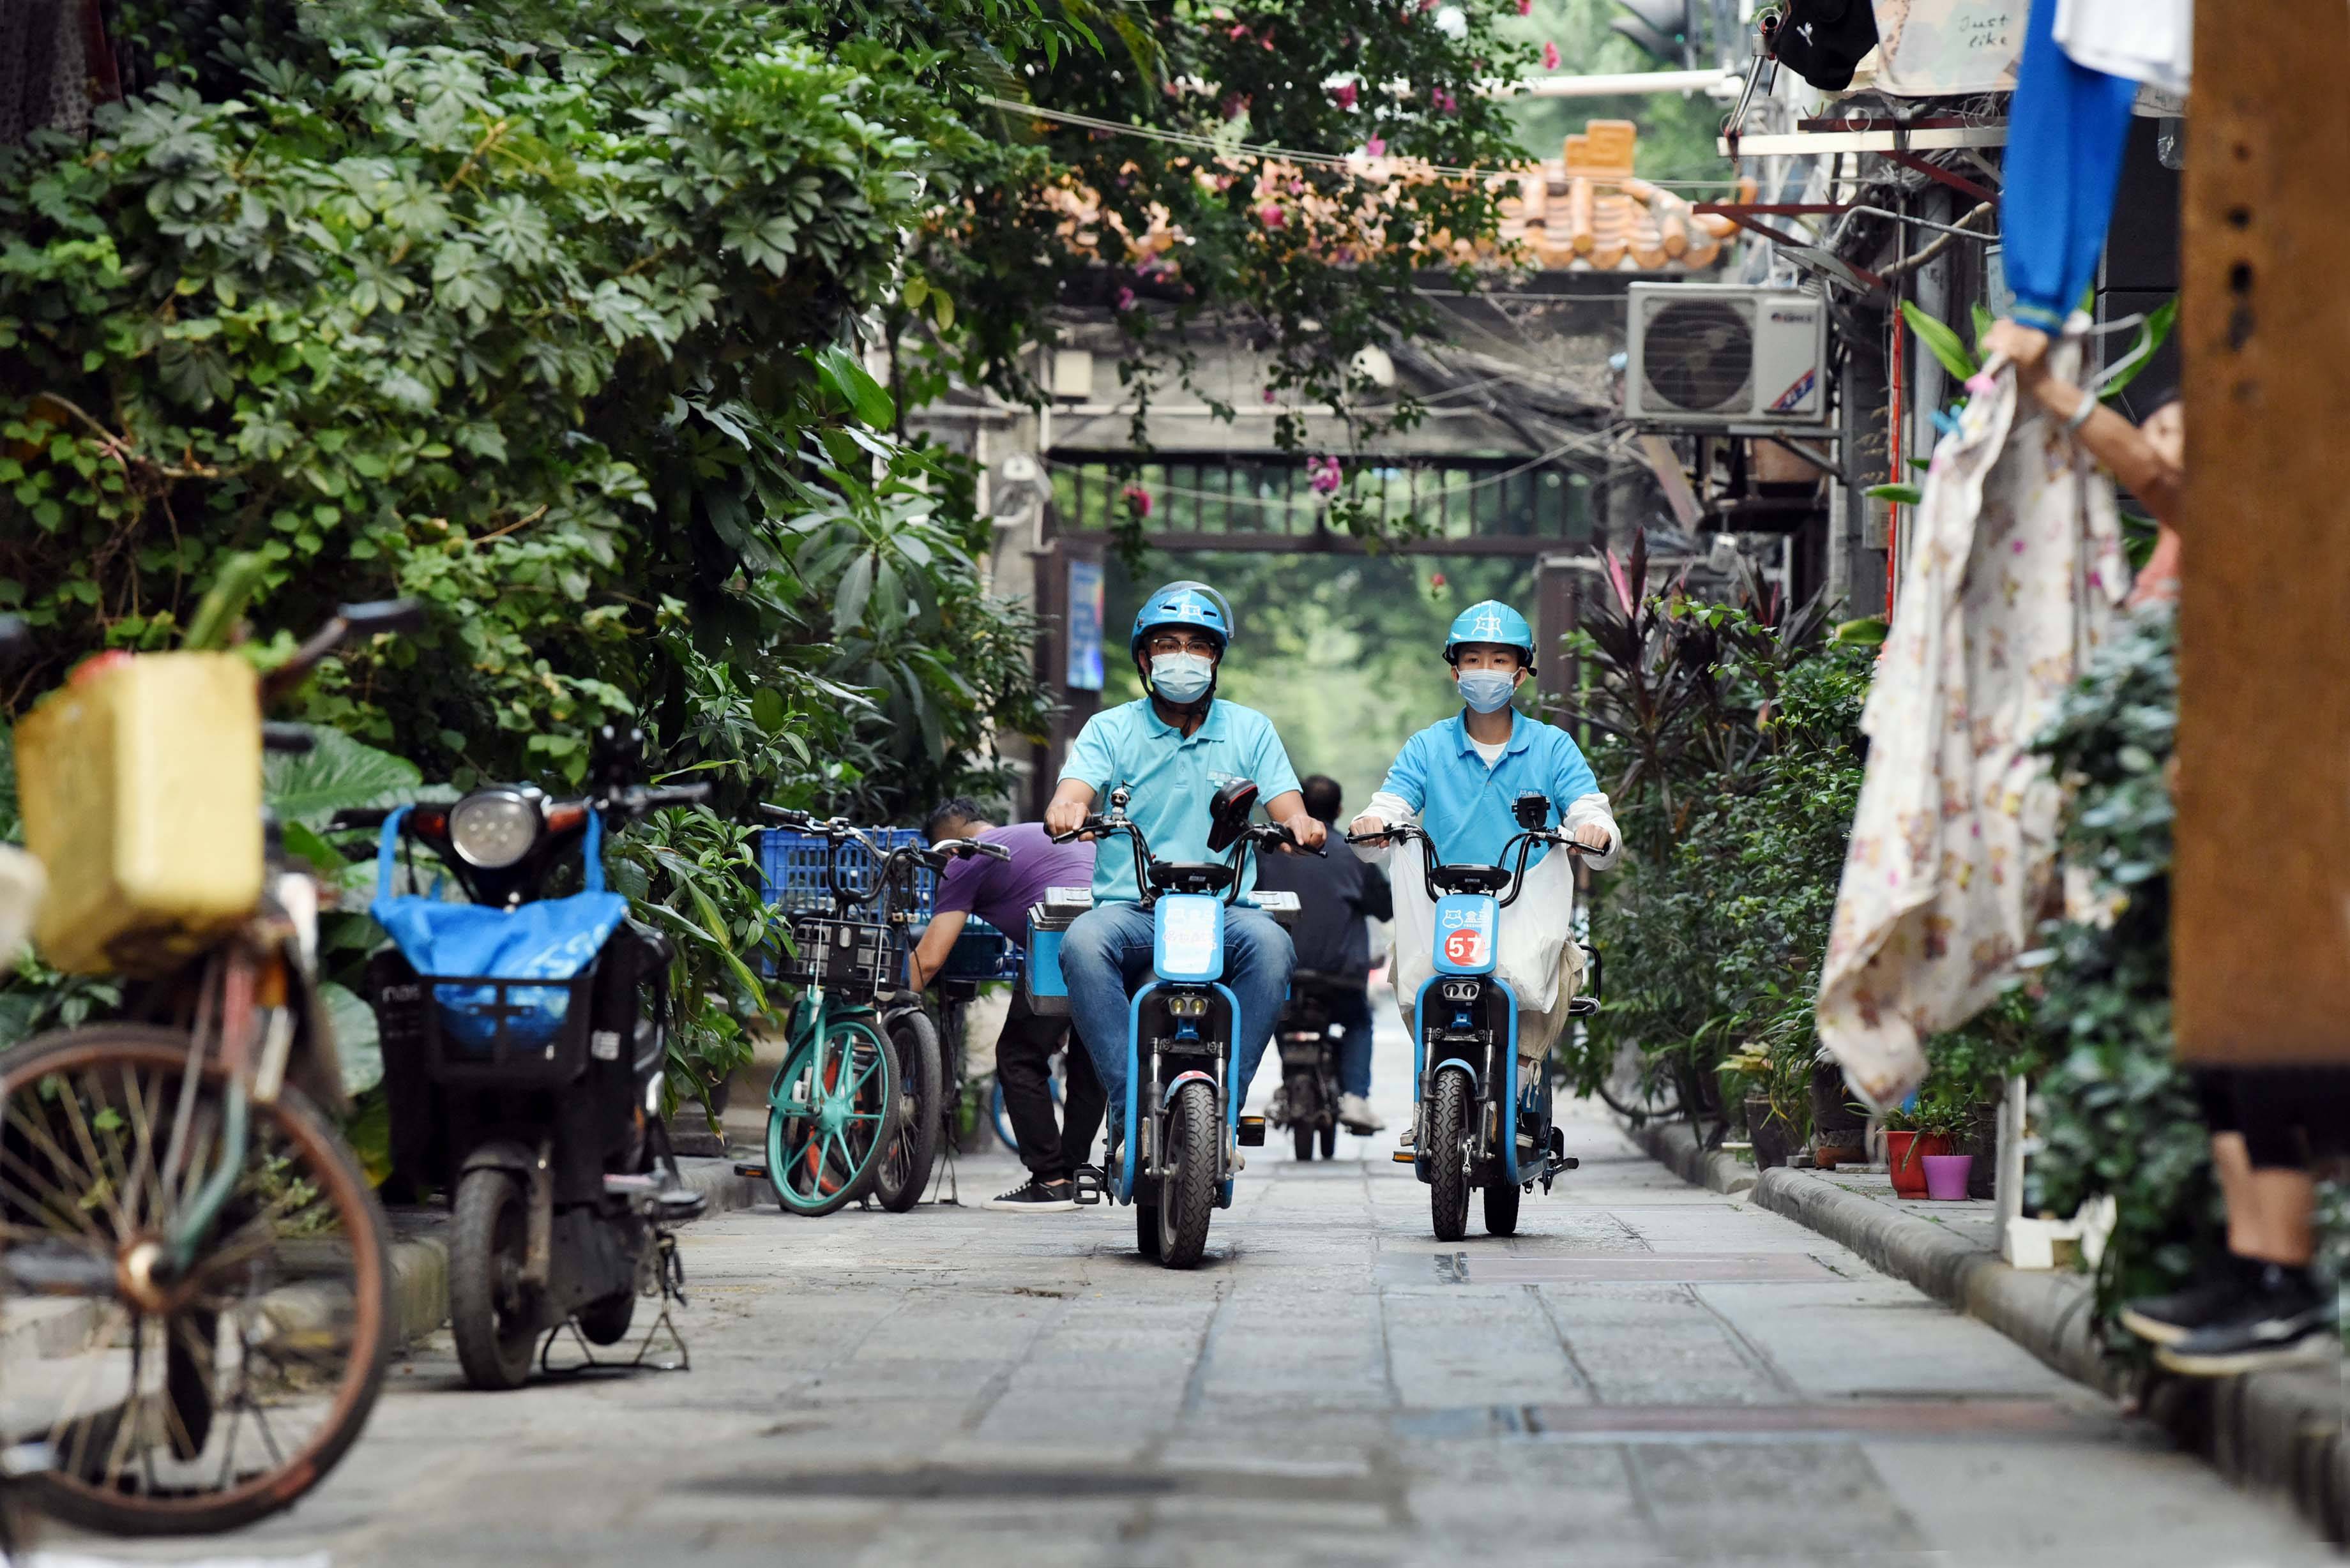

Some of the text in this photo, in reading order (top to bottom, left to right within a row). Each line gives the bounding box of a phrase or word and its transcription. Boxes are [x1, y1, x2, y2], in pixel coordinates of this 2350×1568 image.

[1960, 14, 2009, 32] Just
[1968, 33, 2008, 48] like
[1449, 937, 1482, 958] 57
